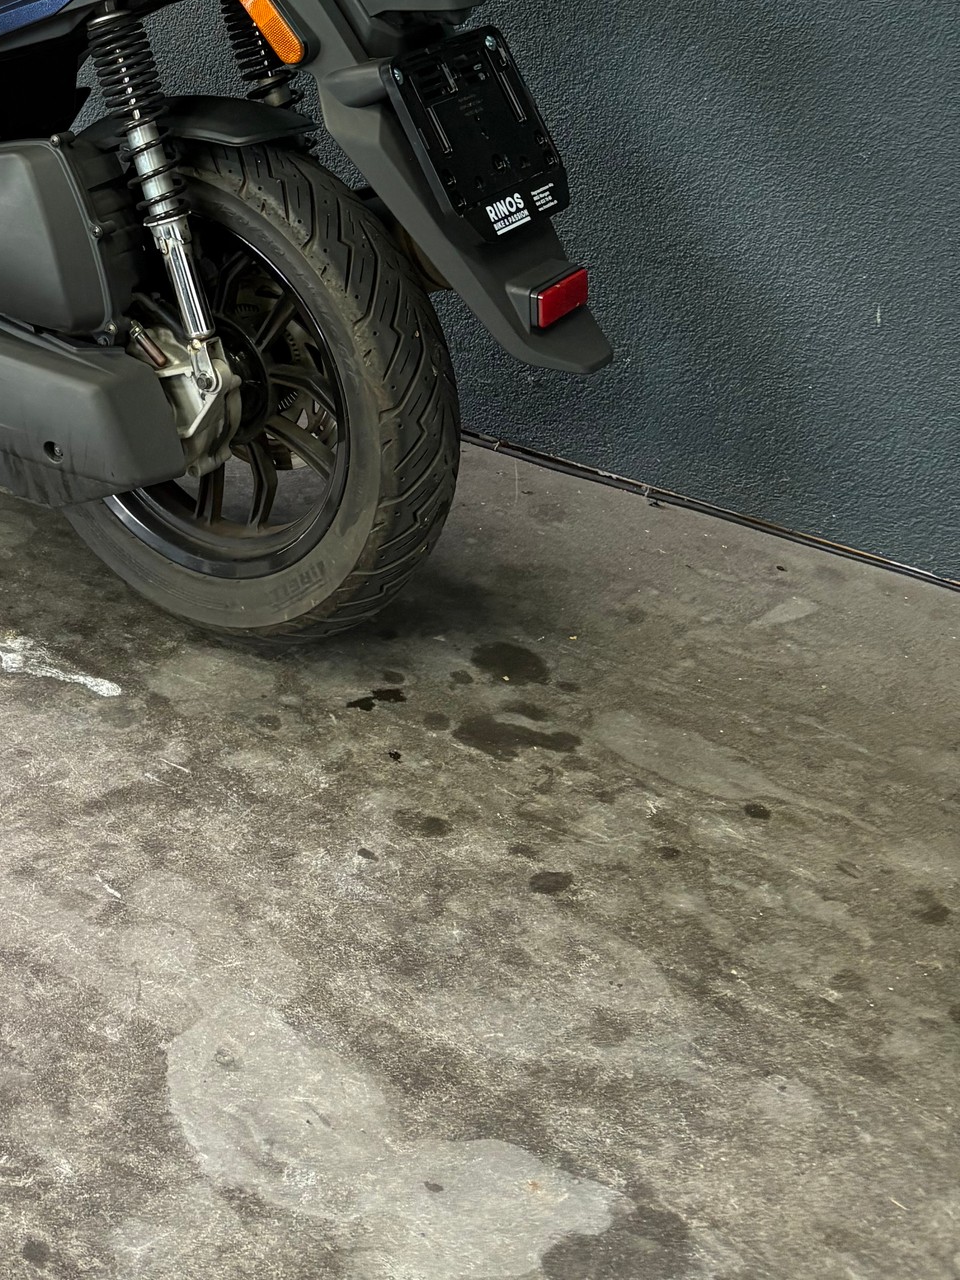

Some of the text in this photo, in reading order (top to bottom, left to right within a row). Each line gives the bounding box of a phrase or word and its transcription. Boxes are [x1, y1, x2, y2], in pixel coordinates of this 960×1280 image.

[485, 192, 525, 223] RINOS
[493, 221, 506, 231] BIKE
[508, 208, 530, 224] PASSION
